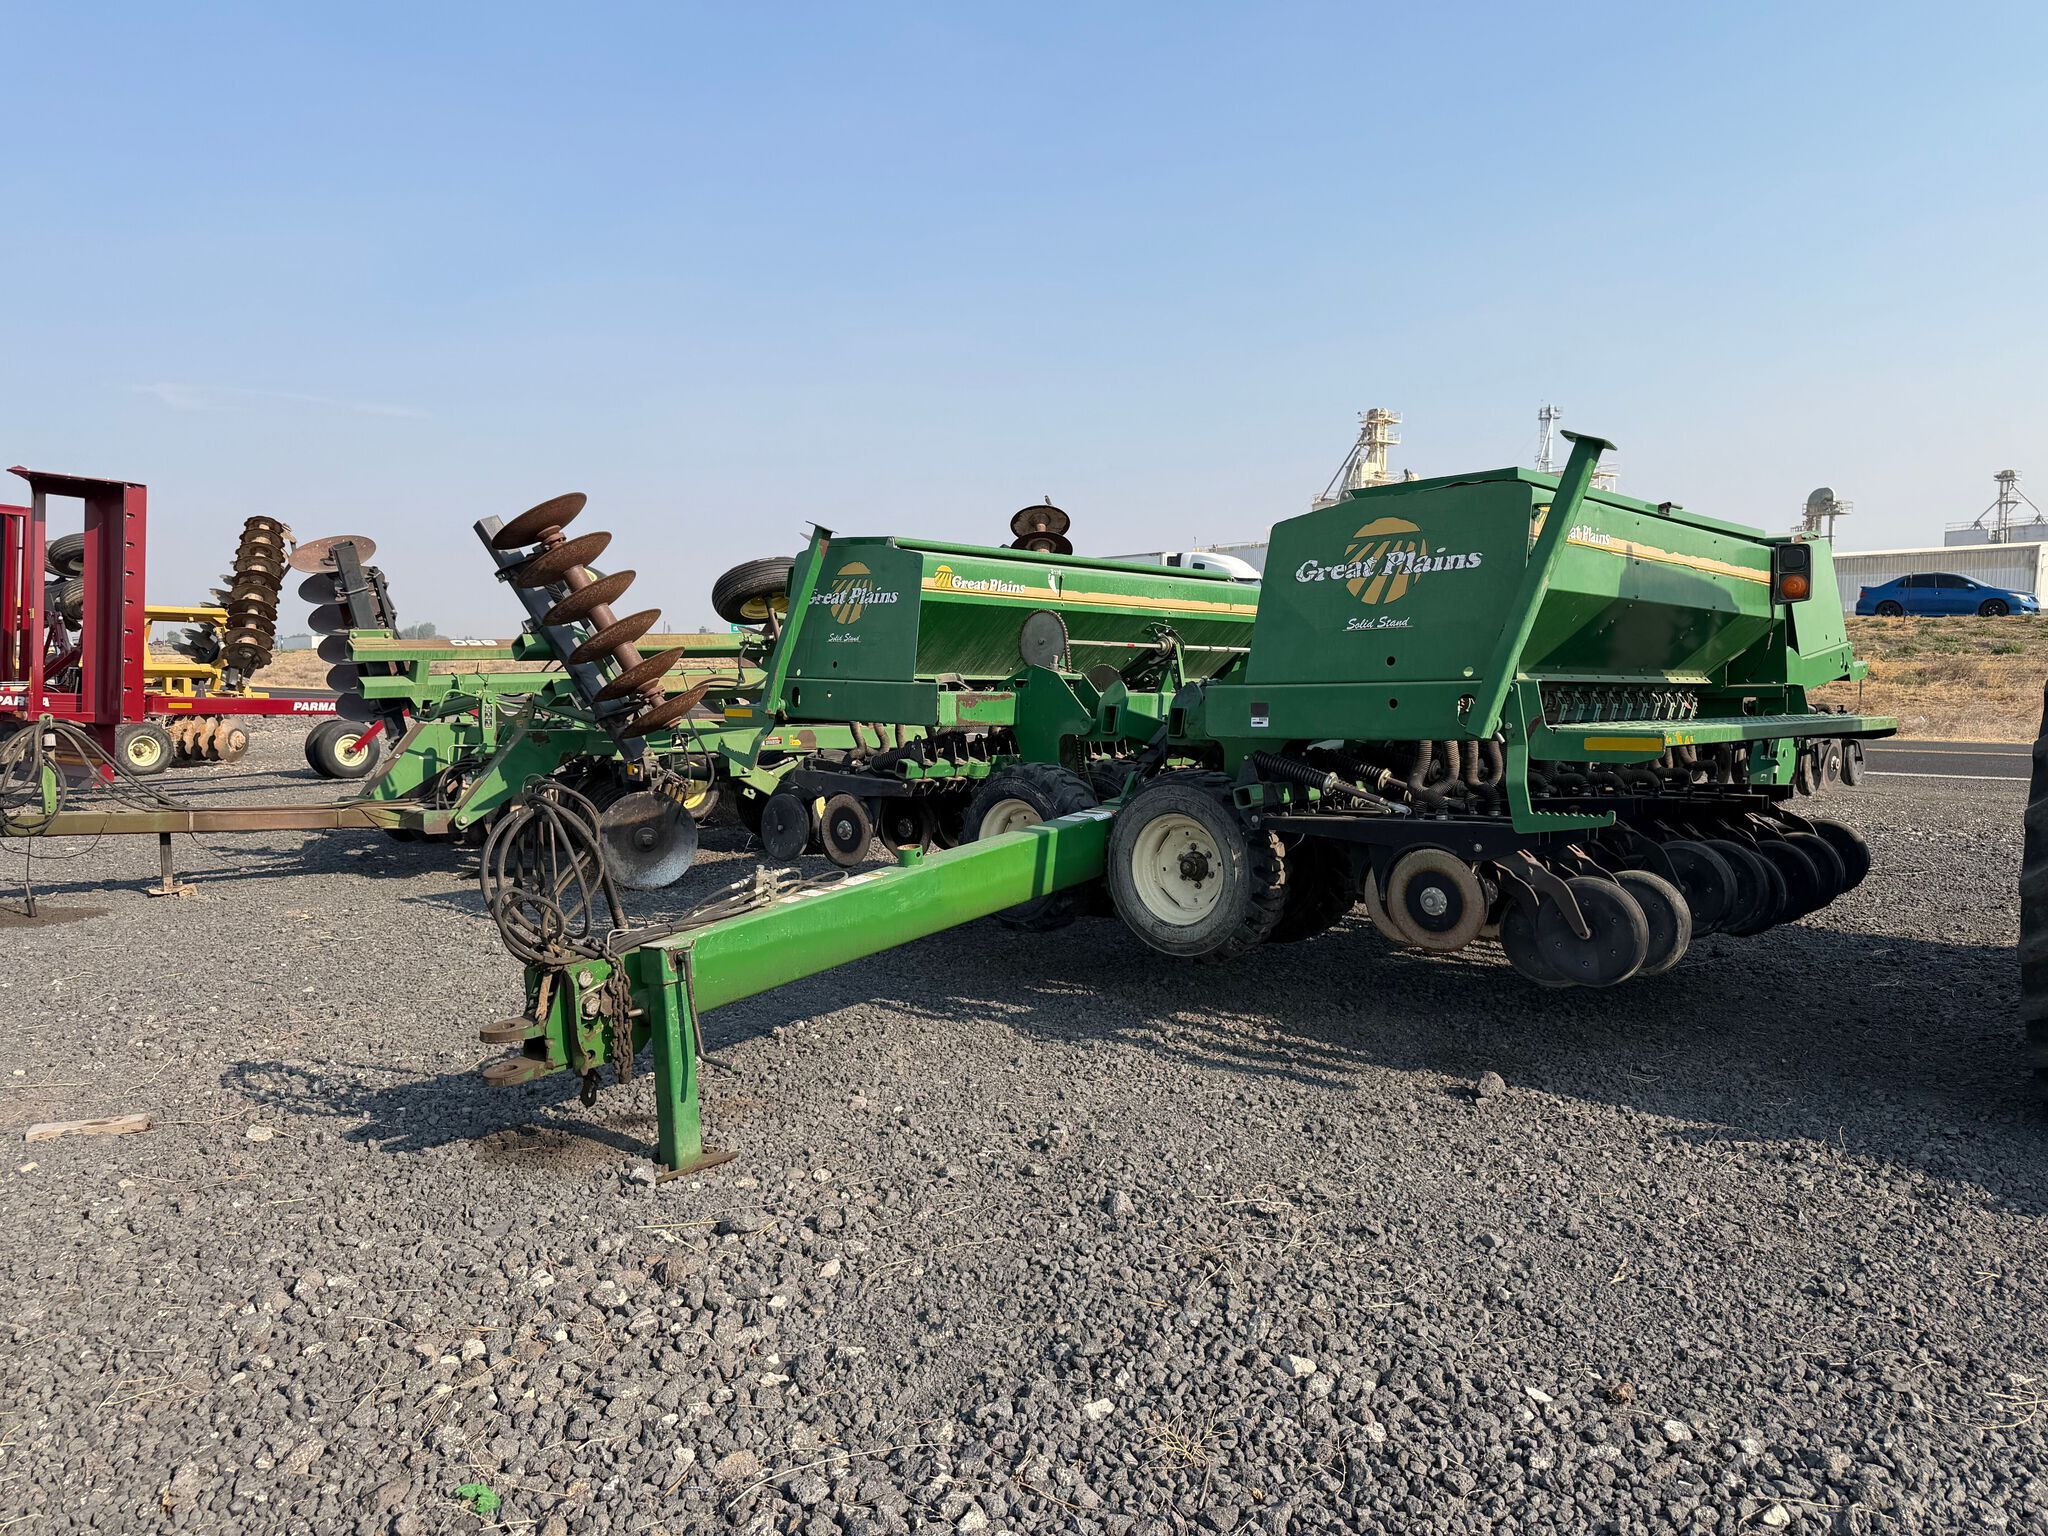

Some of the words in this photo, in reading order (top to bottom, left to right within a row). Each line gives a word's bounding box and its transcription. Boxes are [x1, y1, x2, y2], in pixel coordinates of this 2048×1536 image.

[1582, 525, 1611, 545] Plains
[1295, 556, 1378, 583] Great
[1380, 547, 1484, 577] Plains
[951, 575, 987, 591] Great
[988, 578, 1026, 594] Plains
[848, 586, 899, 605] Plains
[1346, 617, 1375, 630] Solid
[1377, 616, 1410, 629] Stand
[293, 701, 337, 711] PARMA
